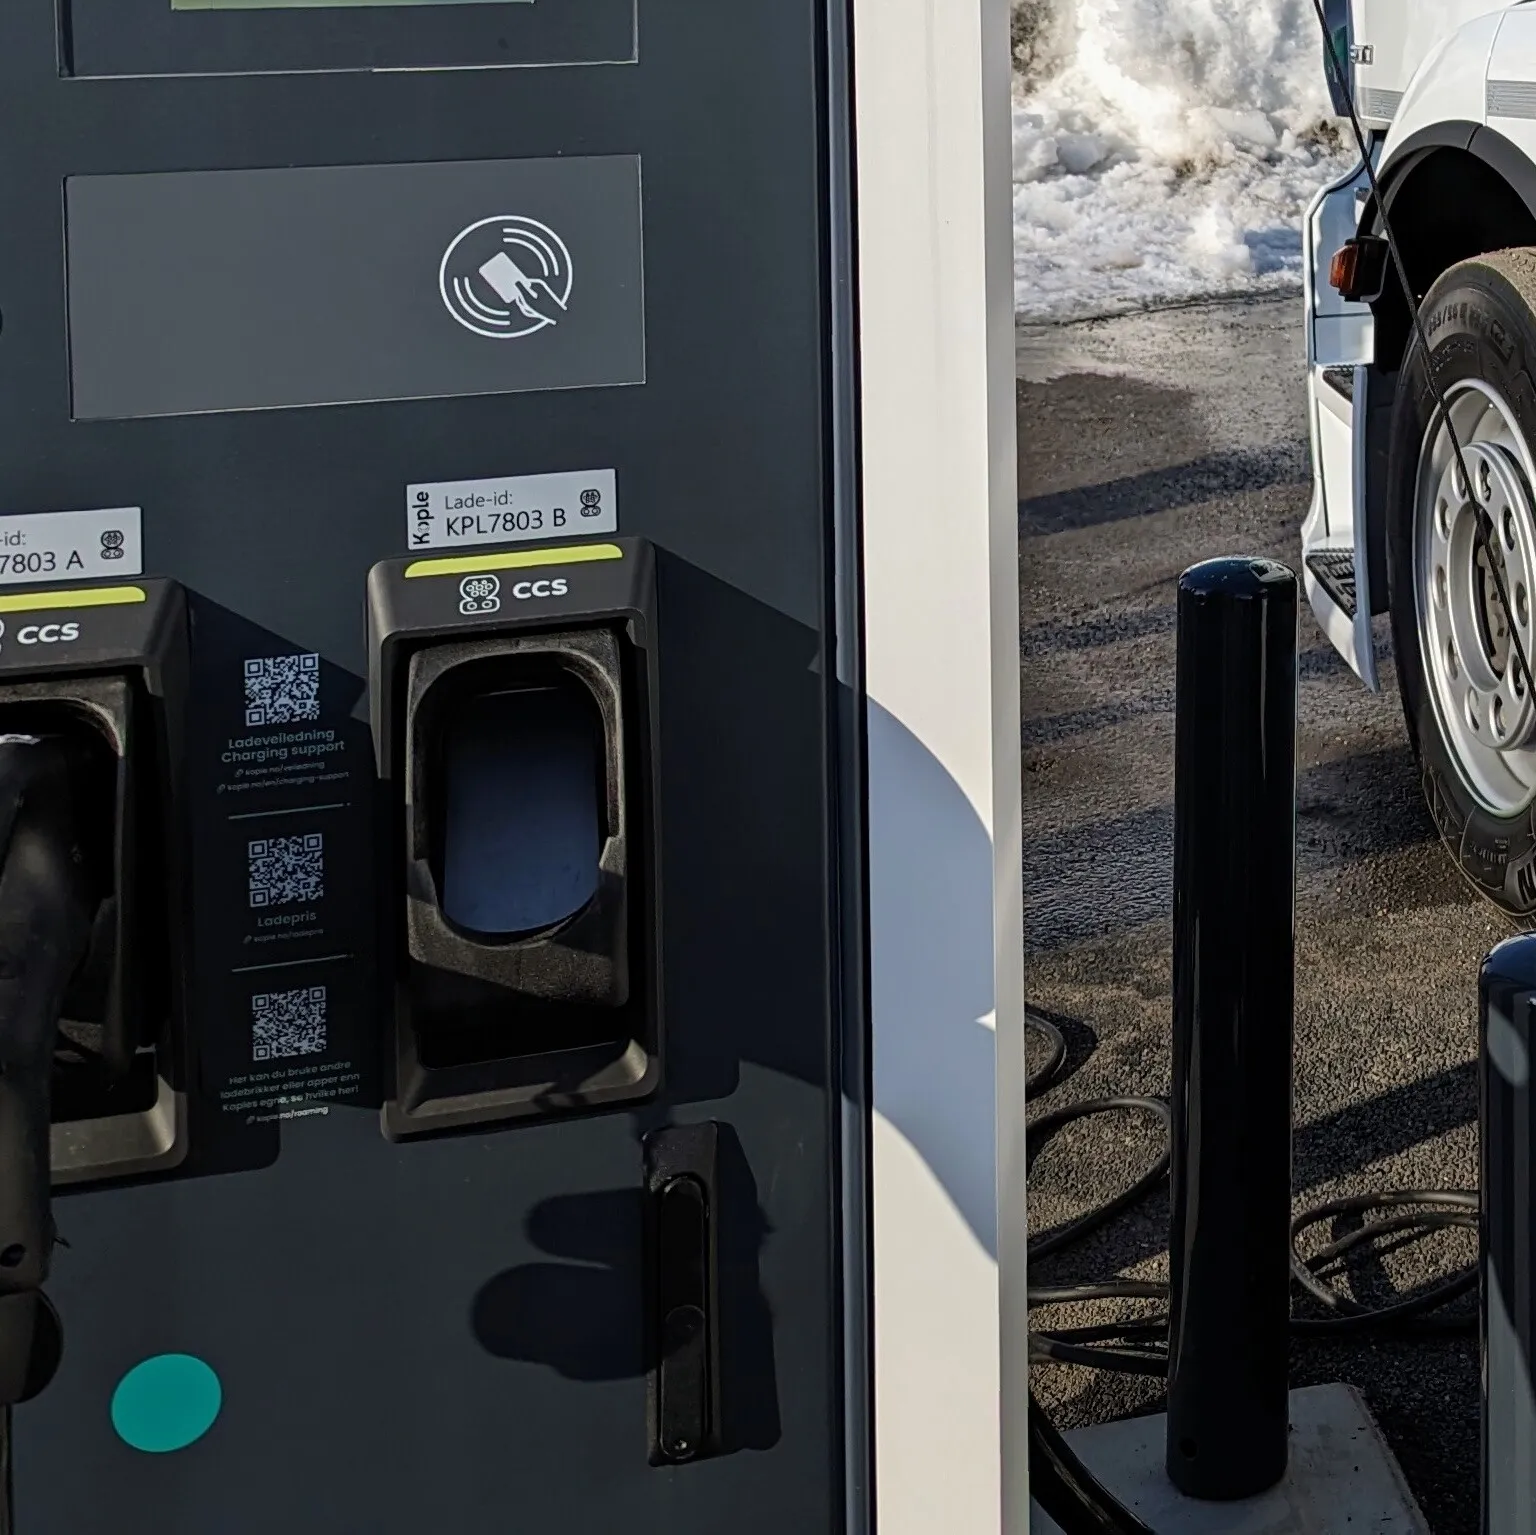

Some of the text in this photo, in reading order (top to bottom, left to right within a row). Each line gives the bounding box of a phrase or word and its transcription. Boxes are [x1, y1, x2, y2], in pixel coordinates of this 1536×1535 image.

[445, 490, 513, 510] Lade-id:
[412, 491, 435, 545] Kople
[446, 508, 567, 537] KPL7803 B
[66, 550, 84, 571] A
[512, 578, 568, 599] CCS
[17, 622, 80, 645] CCS
[228, 729, 335, 750] Ladeveiledning
[221, 740, 345, 763] Charging support
[257, 910, 317, 928] Ladepris
[249, 1072, 270, 1082] kan
[271, 1070, 286, 1079] du
